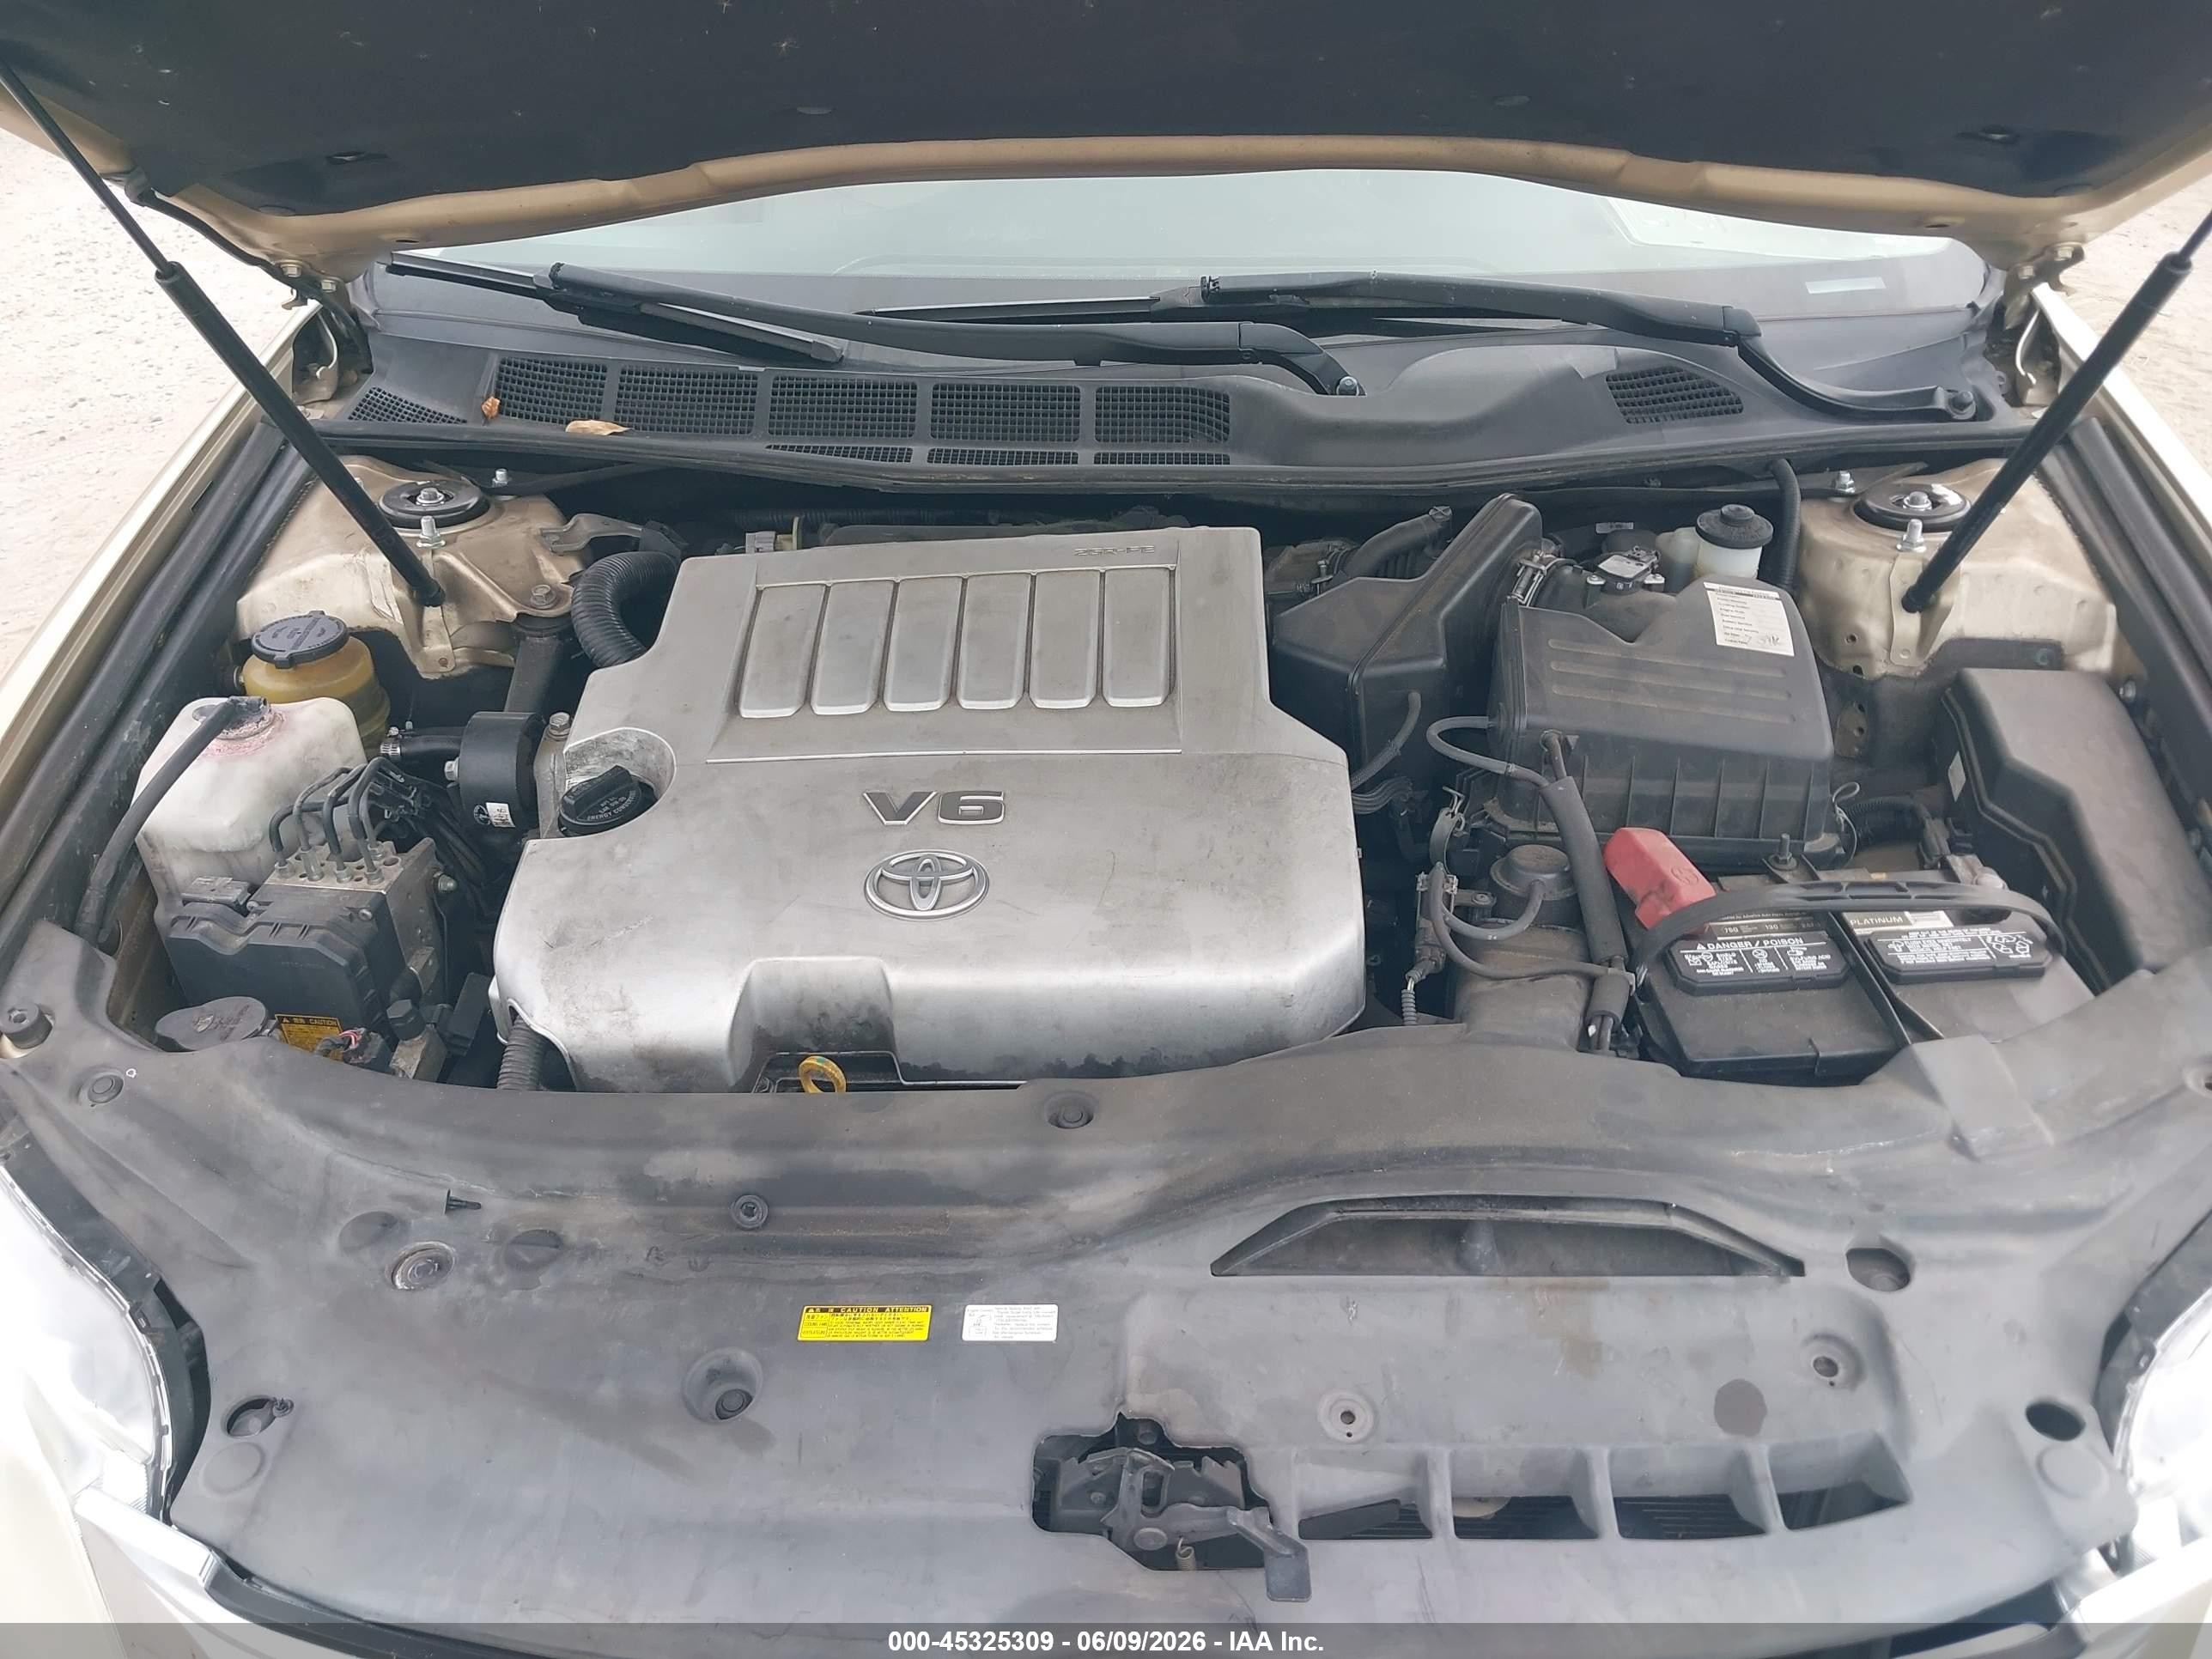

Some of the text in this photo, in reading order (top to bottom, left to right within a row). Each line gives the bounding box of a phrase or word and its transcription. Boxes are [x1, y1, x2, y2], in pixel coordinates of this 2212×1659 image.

[862, 790, 1006, 825] V6
[1850, 915, 1904, 927] PLATINUM
[1707, 940, 1752, 951] DANGER
[1763, 938, 1804, 947] POISON
